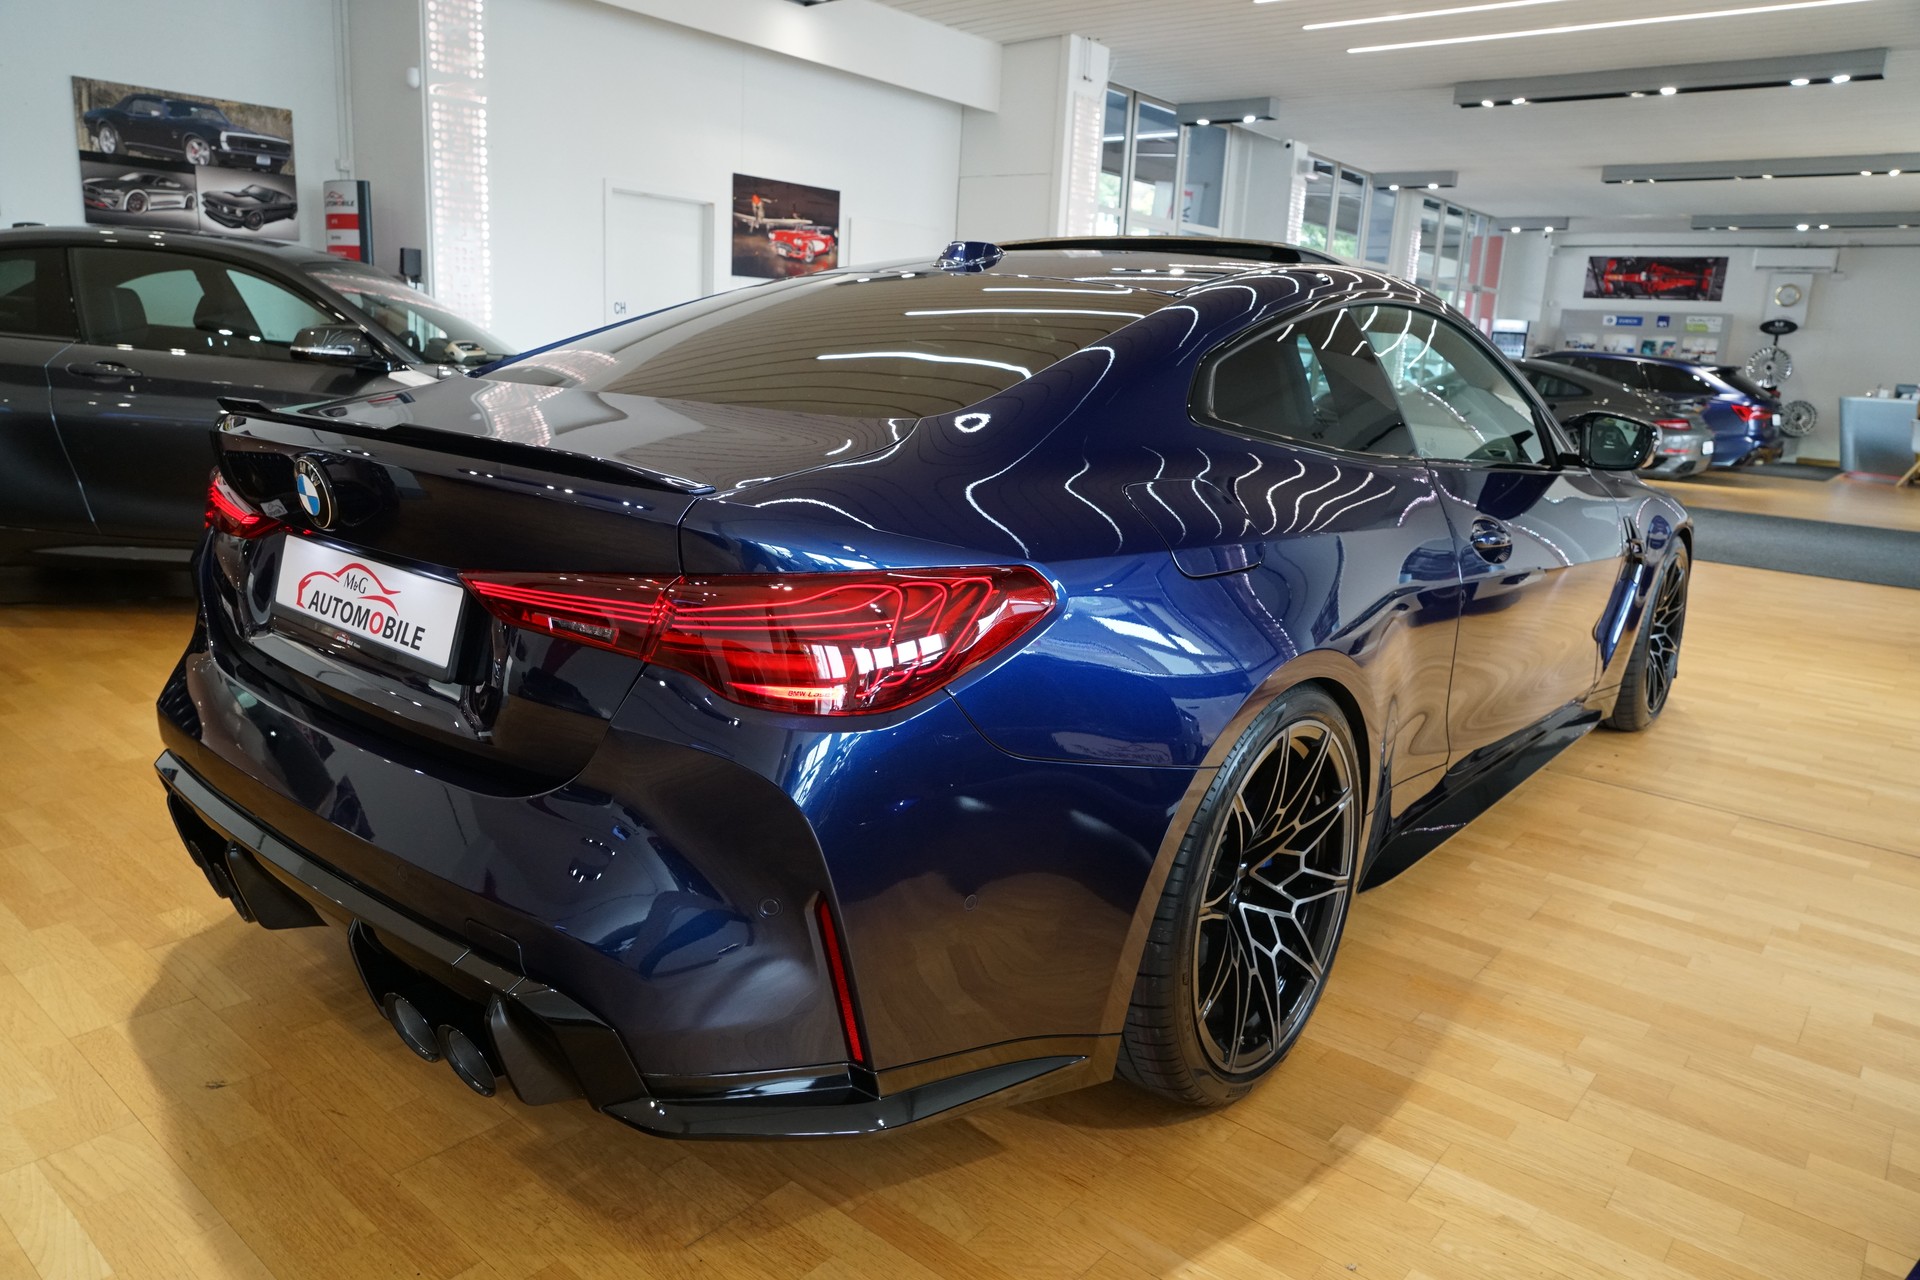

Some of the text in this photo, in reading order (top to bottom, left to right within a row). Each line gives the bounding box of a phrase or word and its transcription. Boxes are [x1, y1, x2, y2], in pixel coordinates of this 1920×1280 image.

[614, 302, 627, 315] CH
[297, 461, 321, 487] MW
[343, 572, 369, 595] M&G
[308, 590, 426, 651] AUTOMOBILE
